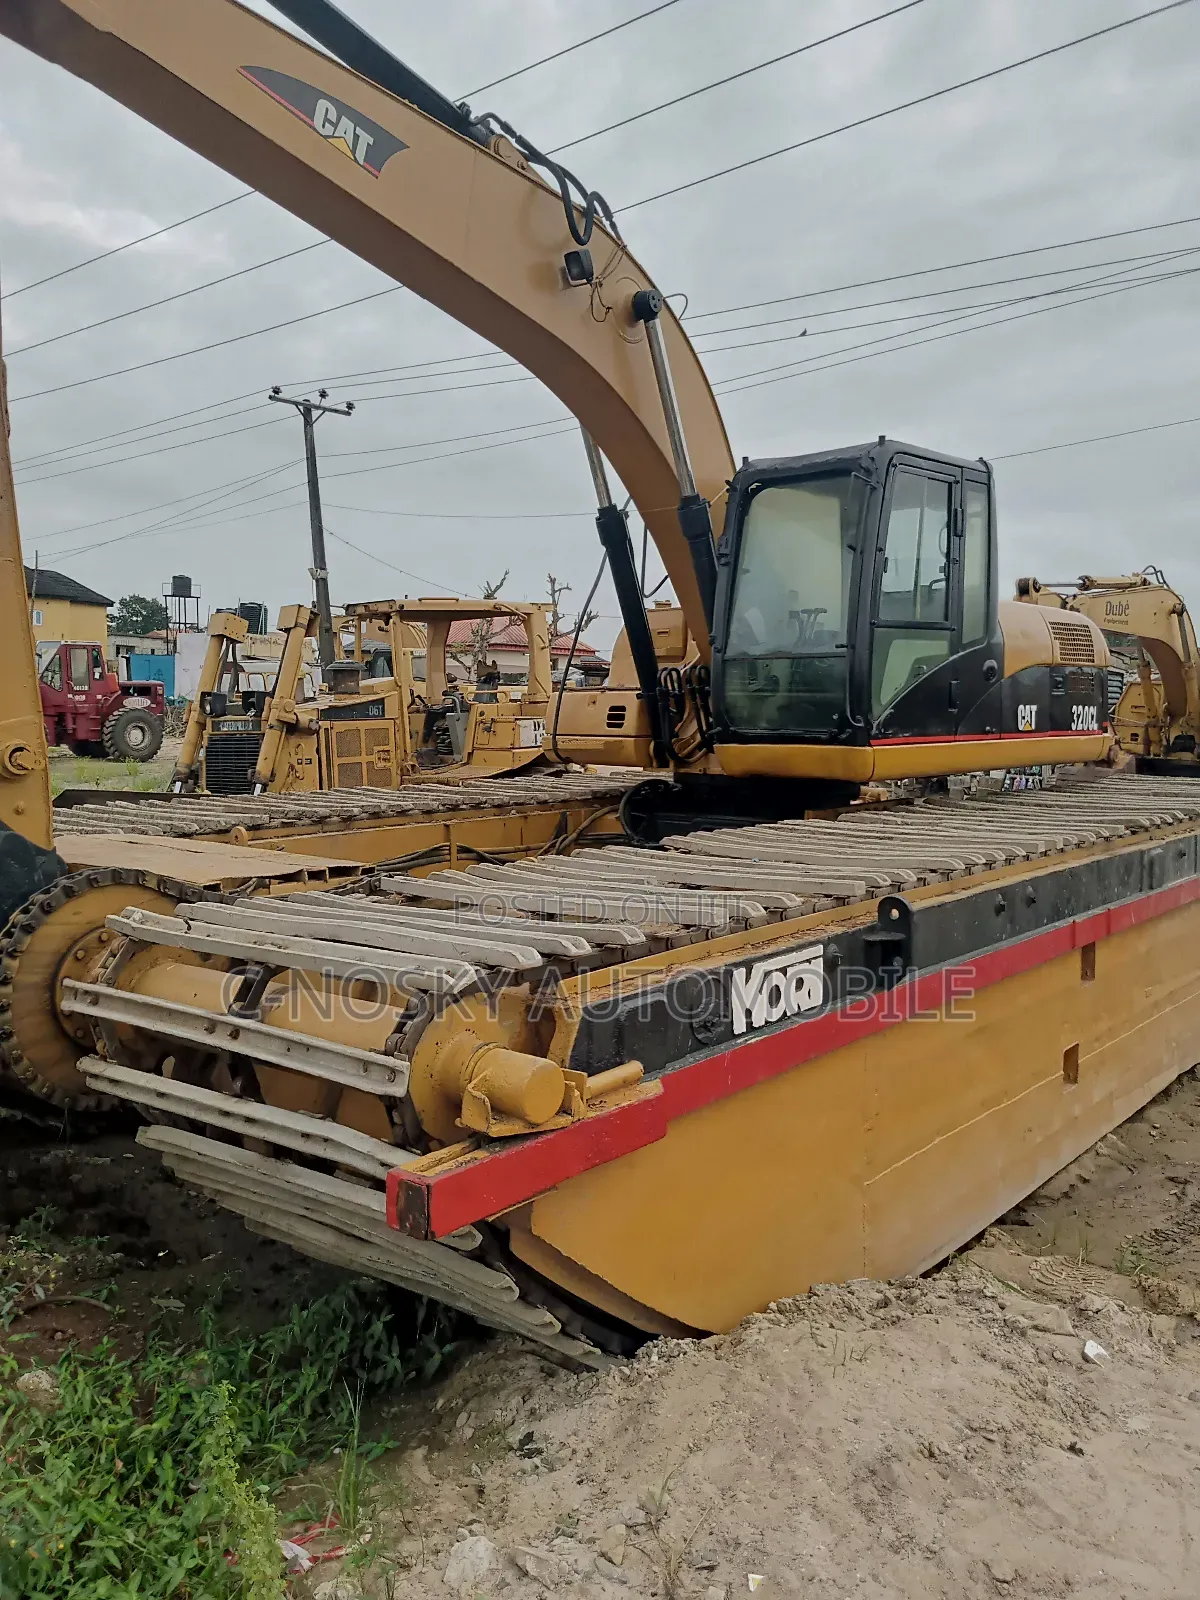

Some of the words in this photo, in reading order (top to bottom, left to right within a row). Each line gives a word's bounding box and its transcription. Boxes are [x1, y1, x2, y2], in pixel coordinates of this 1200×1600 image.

[313, 98, 374, 165] CAT
[1017, 704, 1038, 731] CAT
[1071, 704, 1099, 731] 320CL
